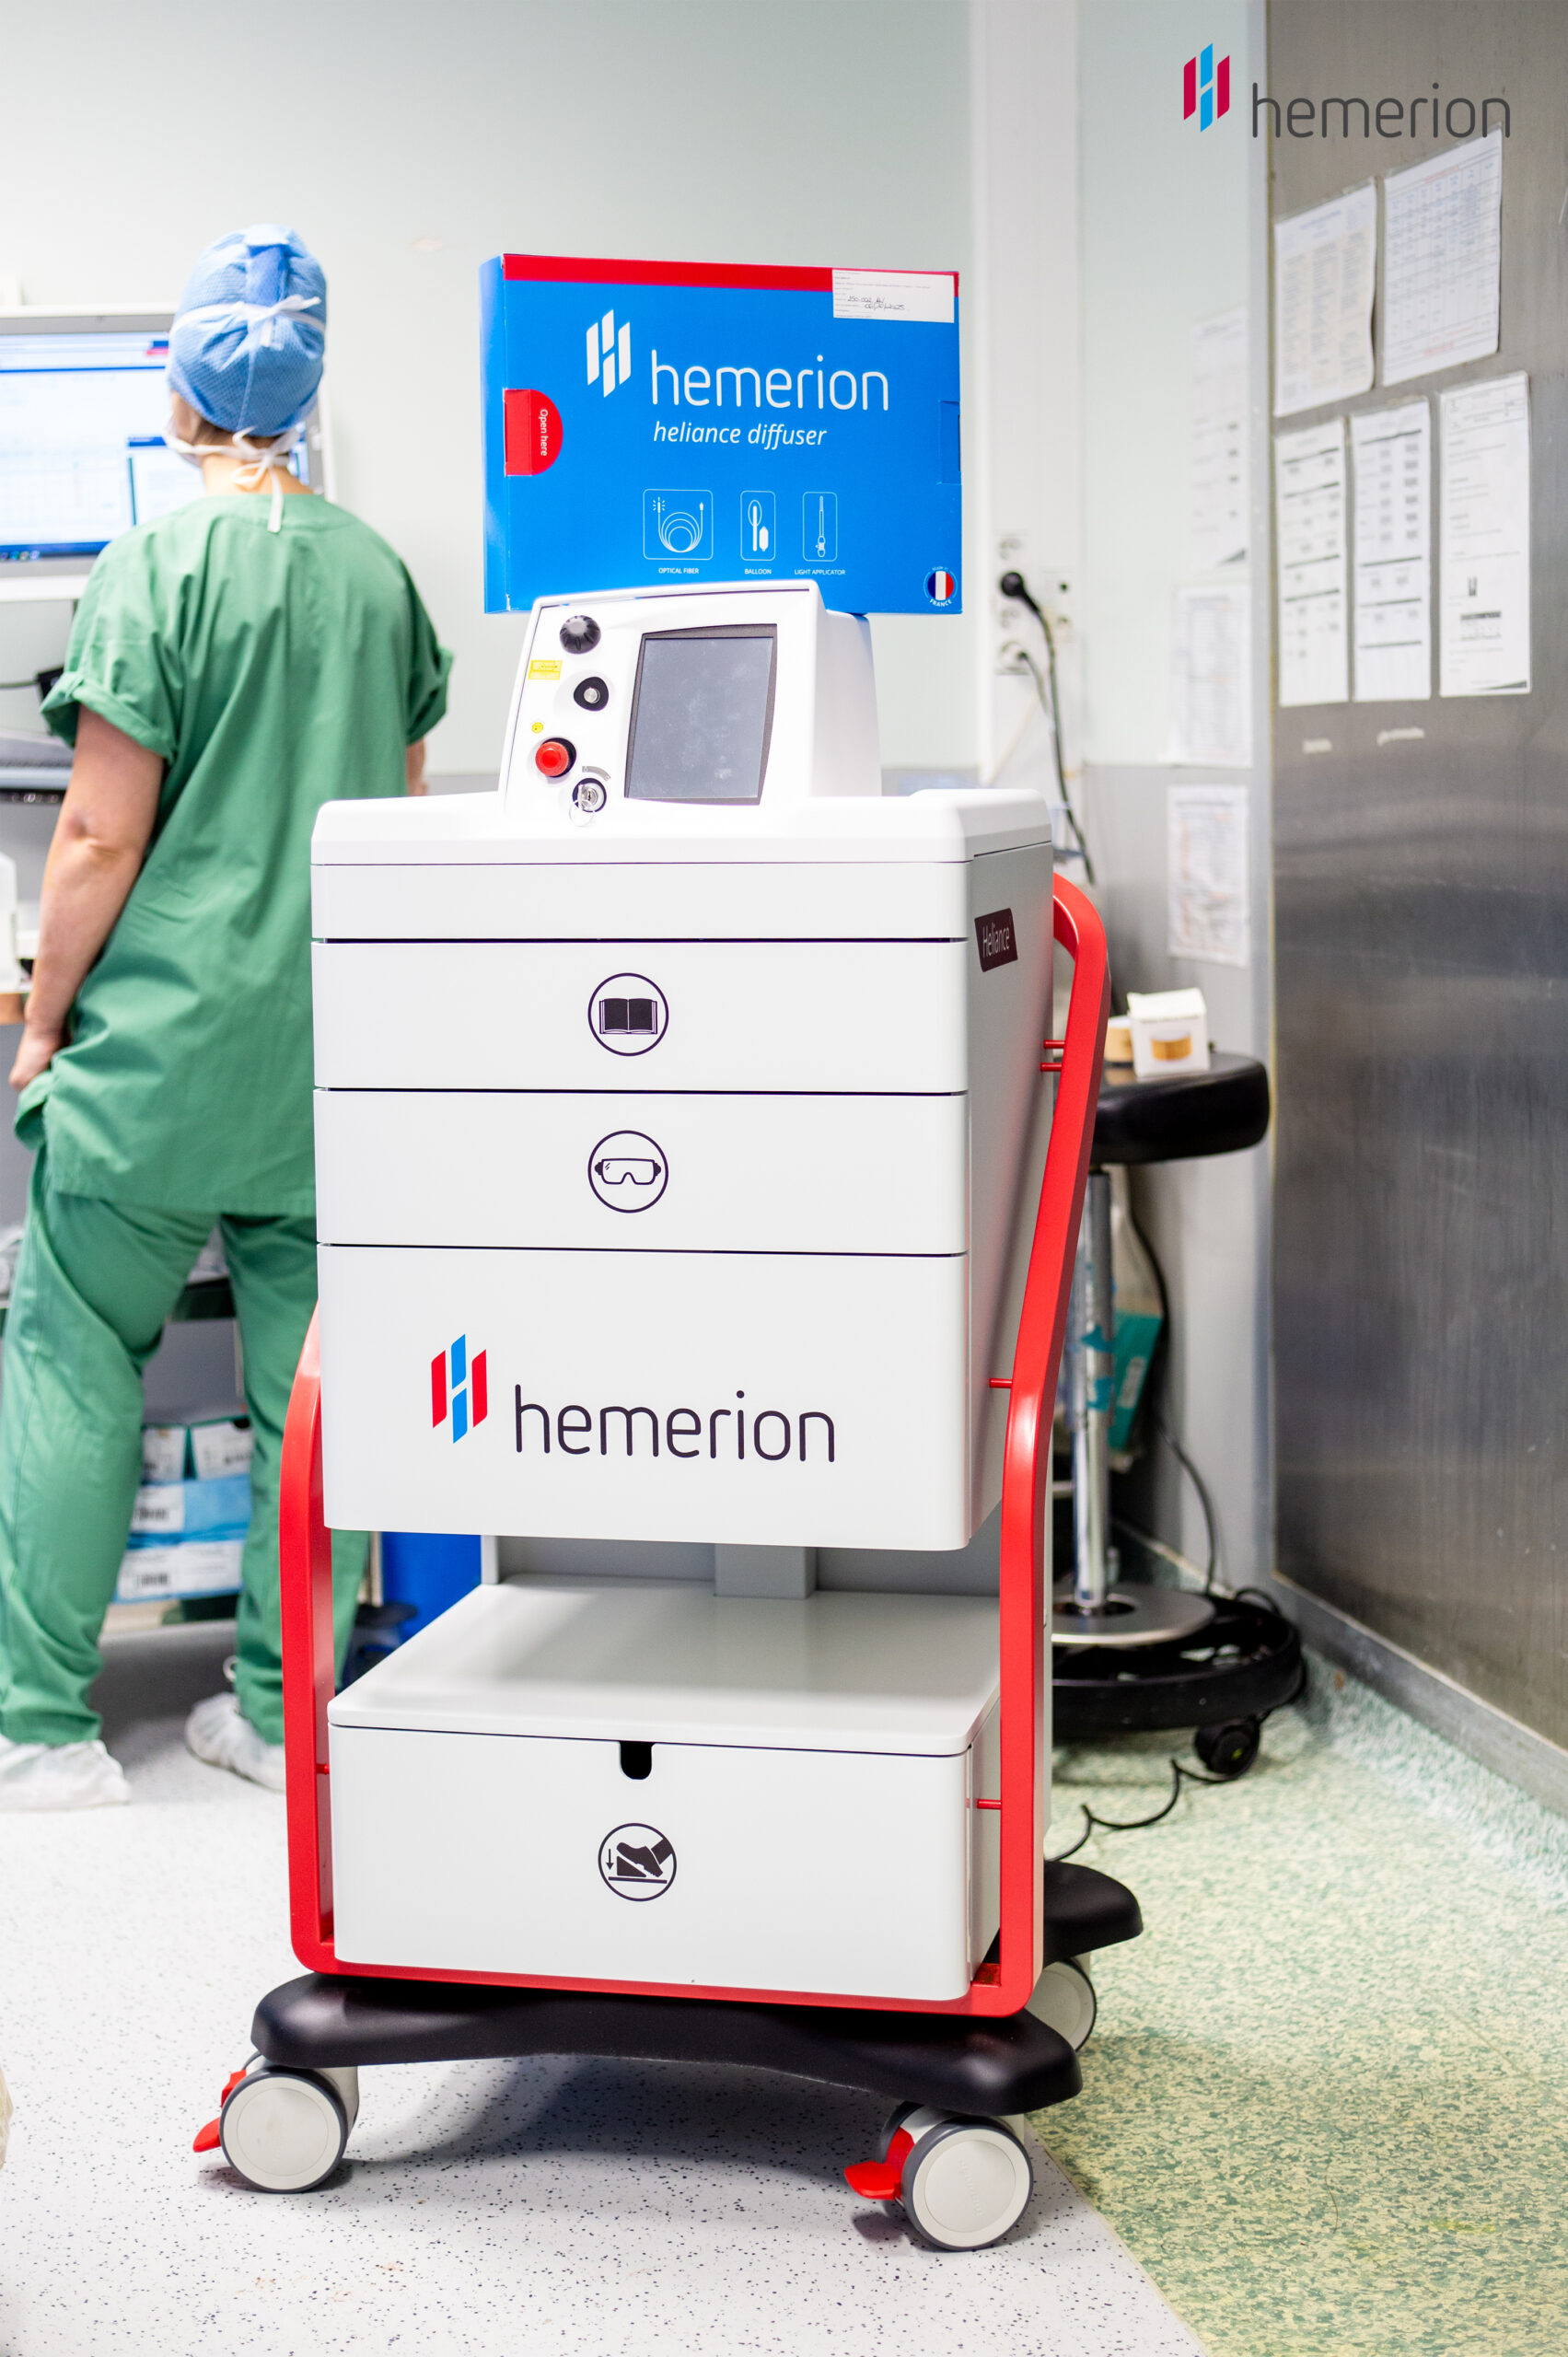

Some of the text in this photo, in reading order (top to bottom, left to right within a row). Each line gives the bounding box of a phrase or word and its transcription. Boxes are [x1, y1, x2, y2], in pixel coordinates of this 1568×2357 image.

[651, 349, 889, 412] hemerion
[539, 409, 549, 457] Open here
[653, 421, 828, 450] heliance diffuser
[930, 598, 952, 608] FRANCE
[982, 922, 1010, 958] Heliance
[515, 1384, 835, 1463] hemerion
